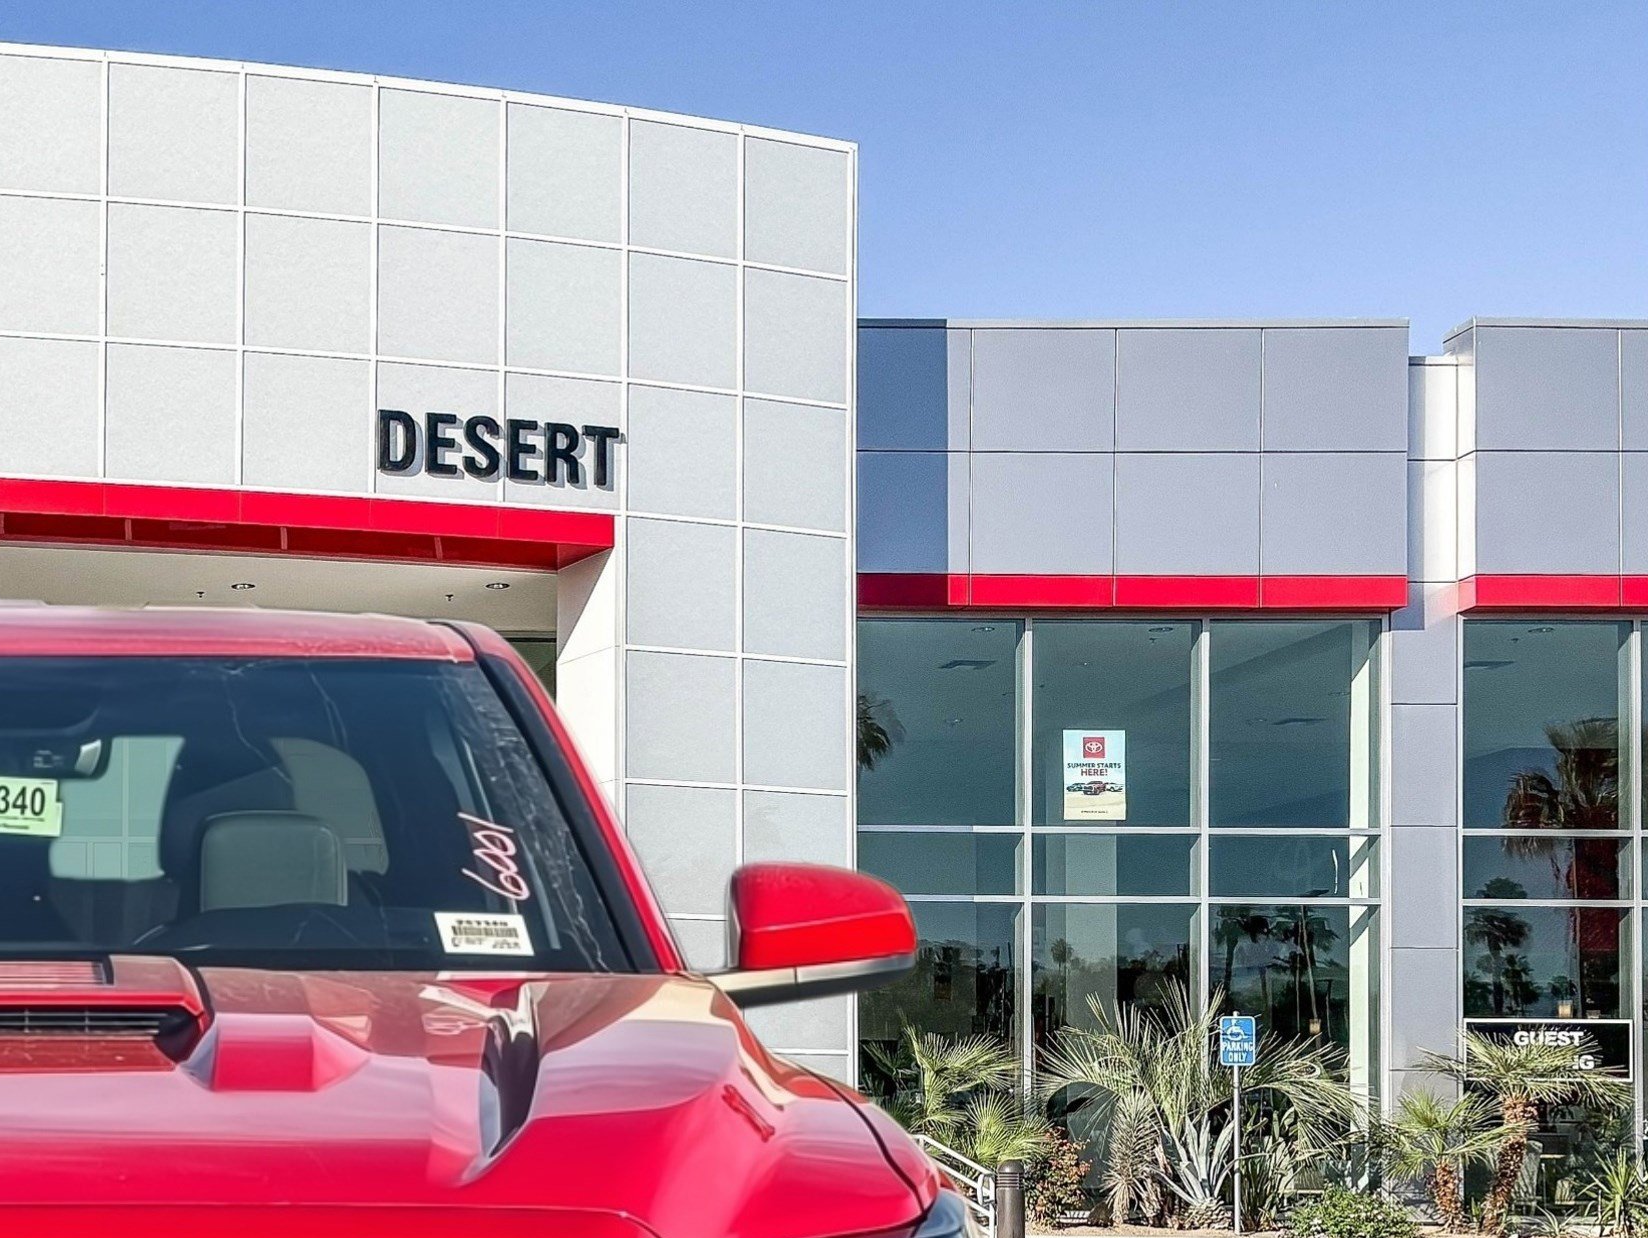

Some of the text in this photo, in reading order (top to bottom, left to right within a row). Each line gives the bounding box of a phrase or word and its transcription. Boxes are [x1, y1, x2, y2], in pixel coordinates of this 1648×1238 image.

[377, 409, 620, 487] DESERT
[1080, 768, 1108, 776] HERE!
[1513, 1030, 1584, 1046] GUEST
[1222, 1041, 1253, 1052] PARKING
[1228, 1051, 1247, 1062] ONLY
